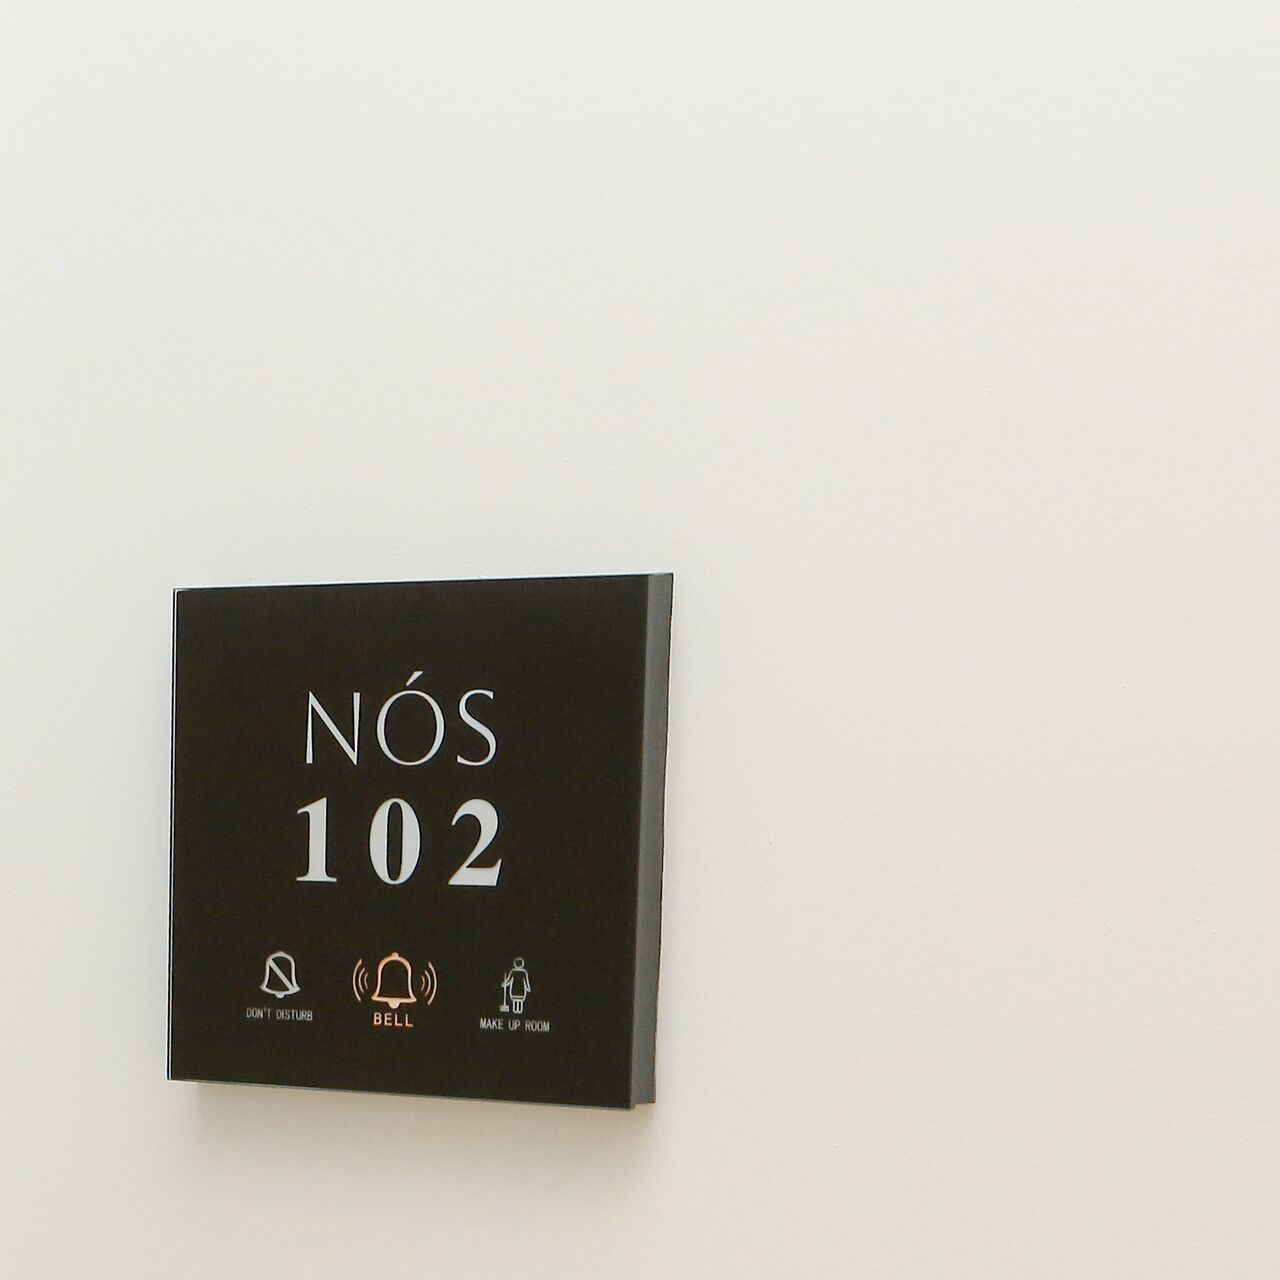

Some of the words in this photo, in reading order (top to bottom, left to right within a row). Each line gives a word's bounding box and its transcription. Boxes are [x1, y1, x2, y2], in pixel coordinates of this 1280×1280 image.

[306, 671, 497, 766] NÓS
[296, 797, 502, 886] 102
[246, 1006, 272, 1020] DON'T
[275, 1008, 314, 1022] DISTURB
[372, 1011, 414, 1028] BELL
[479, 1017, 504, 1030] MAKE
[507, 1019, 521, 1031] UP
[524, 1020, 550, 1032] ROOM
